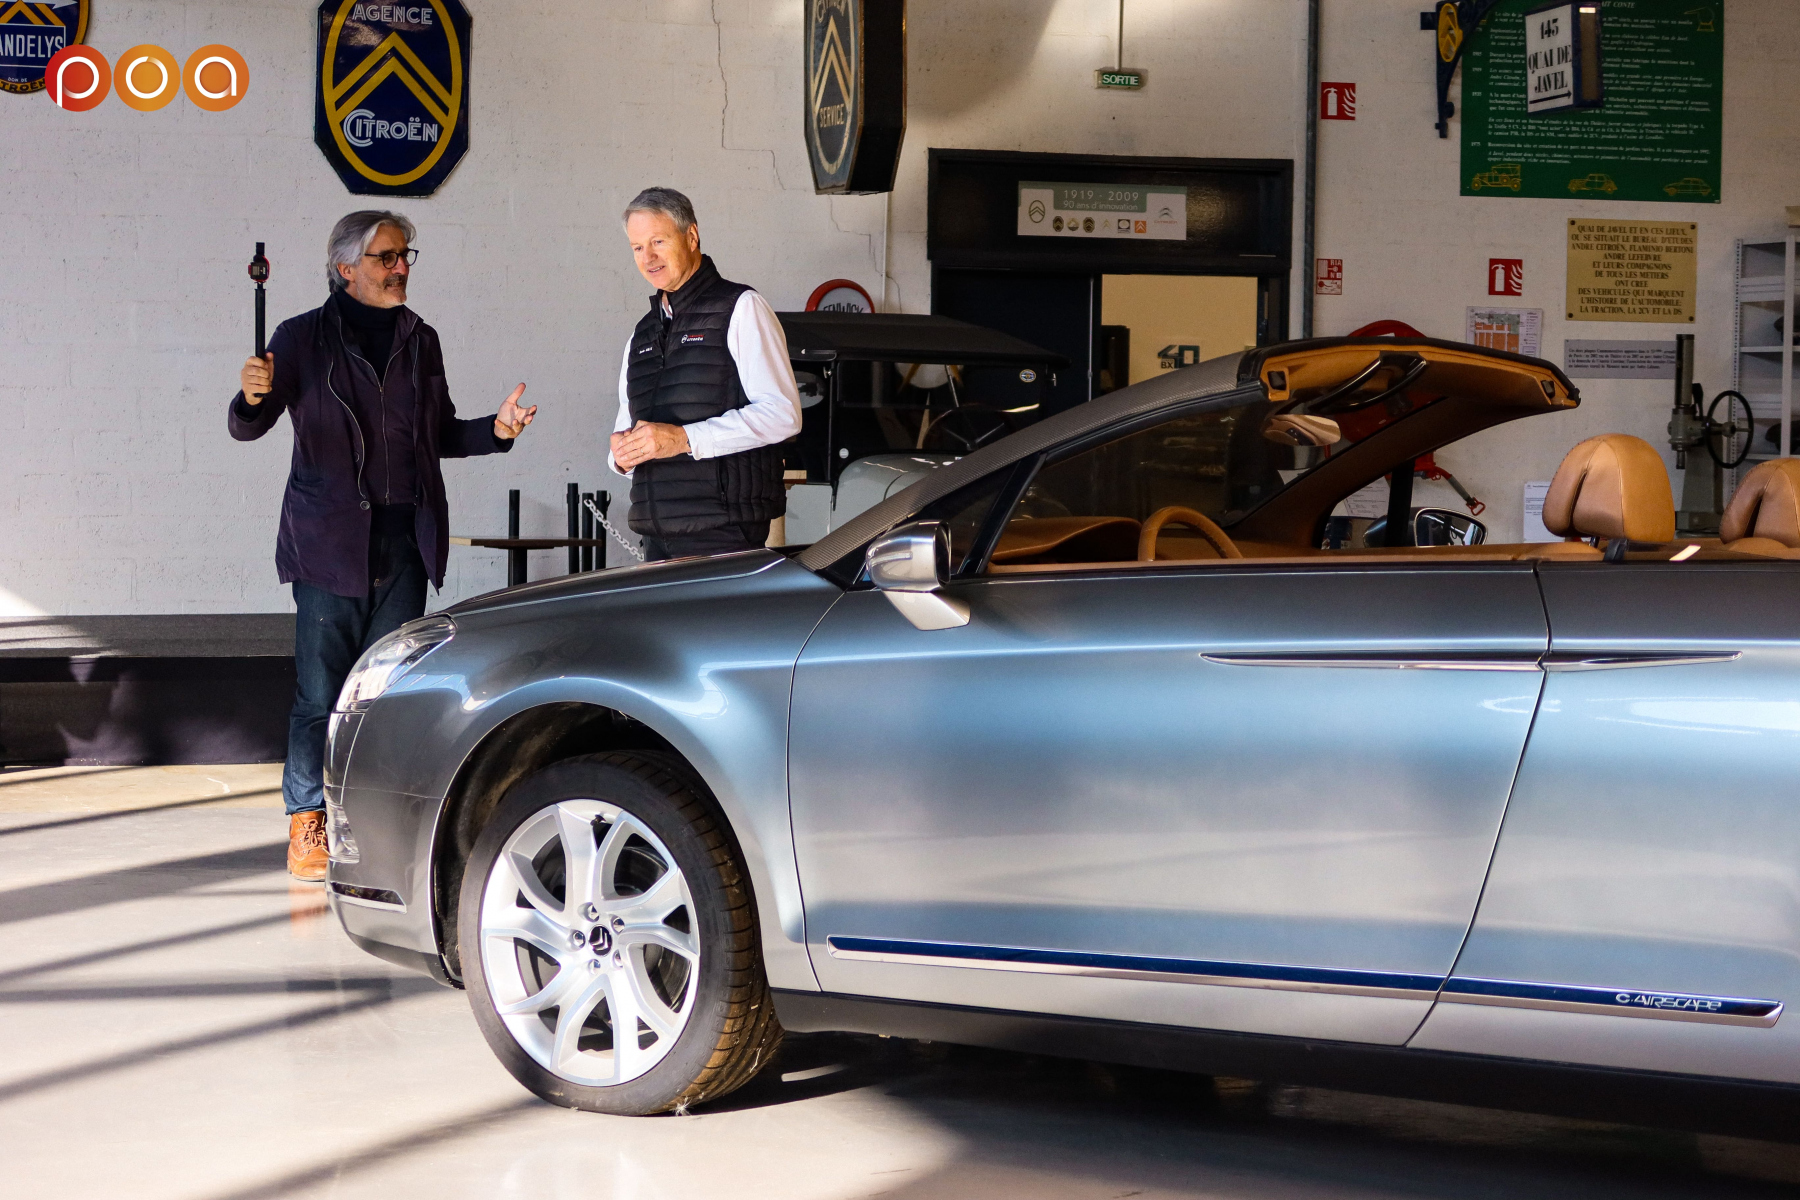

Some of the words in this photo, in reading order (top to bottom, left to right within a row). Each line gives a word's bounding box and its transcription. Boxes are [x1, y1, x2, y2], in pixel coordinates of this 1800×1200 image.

[352, 4, 433, 25] AGENCE
[1541, 18, 1559, 39] 145
[1528, 49, 1553, 74] QUAI
[1557, 45, 1572, 65] DE
[1102, 74, 1139, 85] SORTIE
[1534, 71, 1568, 93] JAVEL
[819, 103, 845, 128] SERVICE
[343, 109, 438, 147] CITROËN
[1064, 190, 1094, 199] 1919
[1108, 191, 1139, 201] 2009
[1063, 200, 1075, 209] 90
[1578, 225, 1595, 234] QUAI
[1596, 225, 1605, 233] DE
[1608, 226, 1627, 234] JAVEL
[1629, 226, 1638, 234] ET
[1651, 227, 1663, 235] CES
[1594, 234, 1620, 242] SITUAIT
[1622, 235, 1630, 243] LE
[1632, 235, 1658, 243] BUREAU
[1665, 246, 1694, 254] BERTONI
[1603, 261, 1625, 269] LEURS
[1626, 262, 1672, 270] COMPAGNONS
[1606, 270, 1624, 278] TOUS
[1640, 271, 1669, 279] METIERS
[1578, 287, 1591, 295] DES
[1593, 288, 1631, 296] VEHICULES
[1632, 289, 1645, 297] QUI
[1647, 290, 1685, 298] MARQUENT
[1580, 305, 1589, 313] LA
[1638, 307, 1650, 315] 2CV
